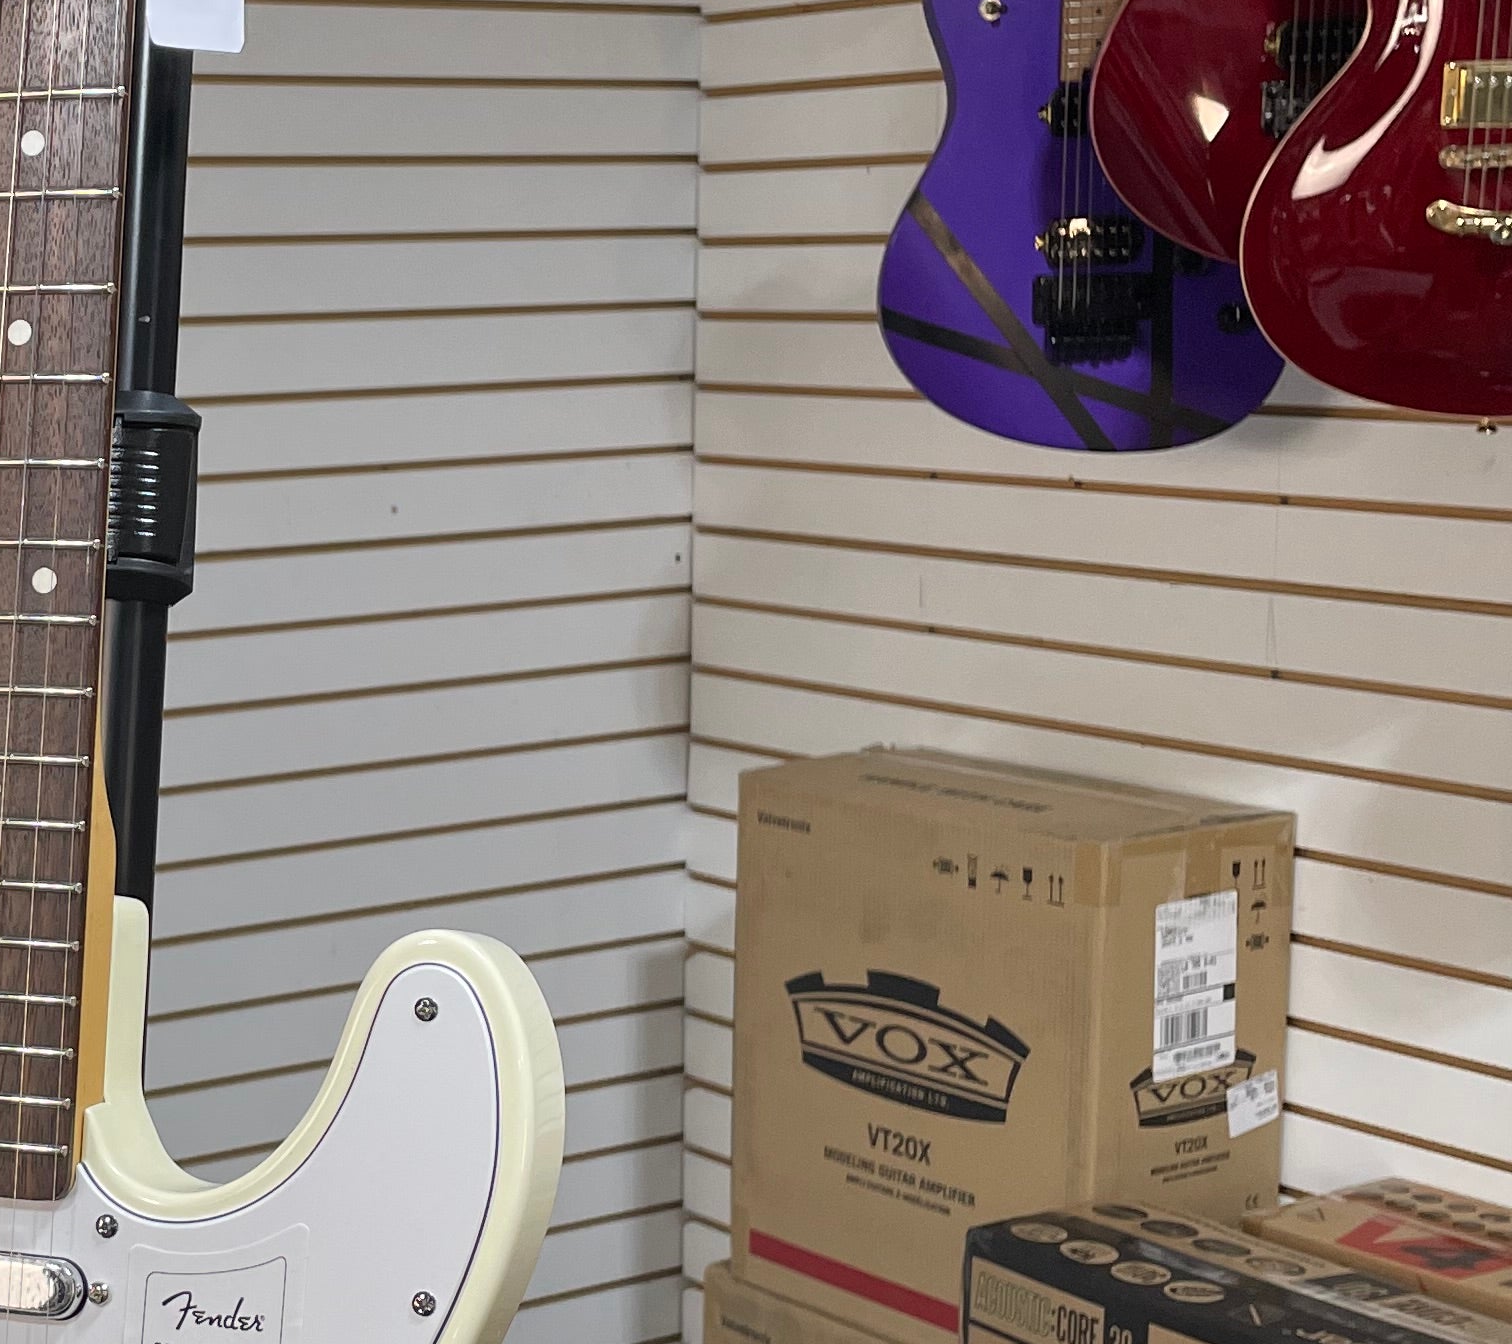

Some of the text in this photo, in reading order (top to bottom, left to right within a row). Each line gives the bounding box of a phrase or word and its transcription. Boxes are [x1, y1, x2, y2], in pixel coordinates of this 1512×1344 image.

[813, 1006, 989, 1087] VOX
[1150, 1071, 1235, 1104] VOX
[867, 1122, 932, 1166] VT20X
[161, 1290, 265, 1333] Fender
